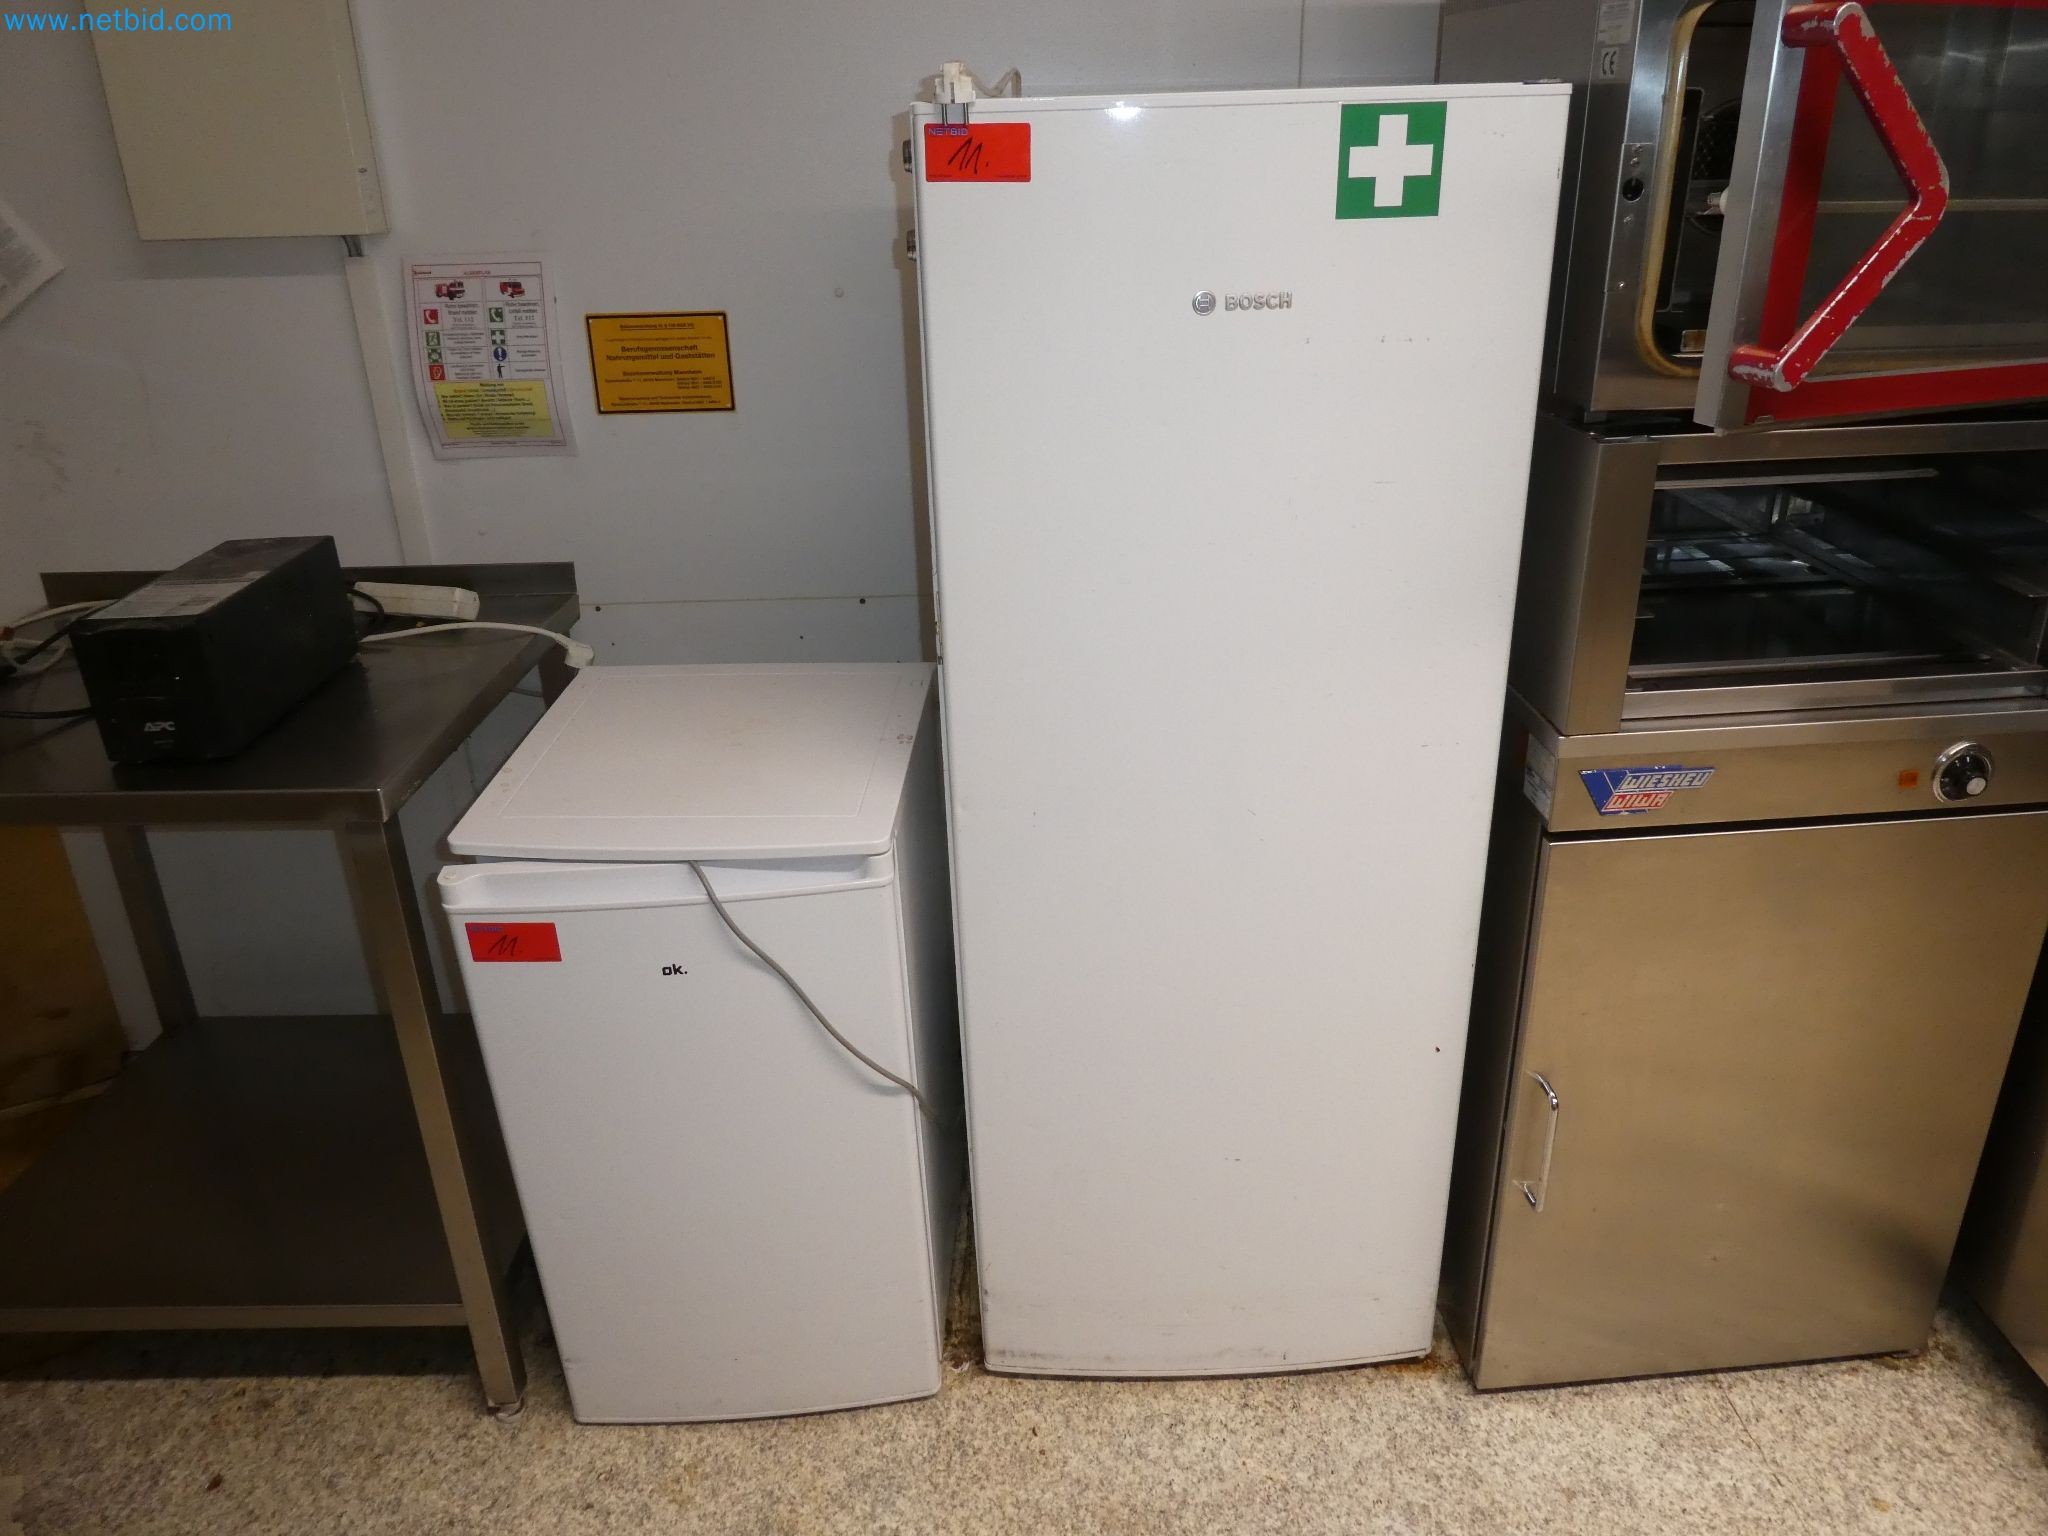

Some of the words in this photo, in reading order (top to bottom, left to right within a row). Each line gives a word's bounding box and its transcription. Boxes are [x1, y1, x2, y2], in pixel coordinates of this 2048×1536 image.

[928, 127, 968, 136] NETBID
[1225, 292, 1292, 312] BOSCH
[144, 721, 176, 732] APC
[1603, 792, 1668, 810] WIWA
